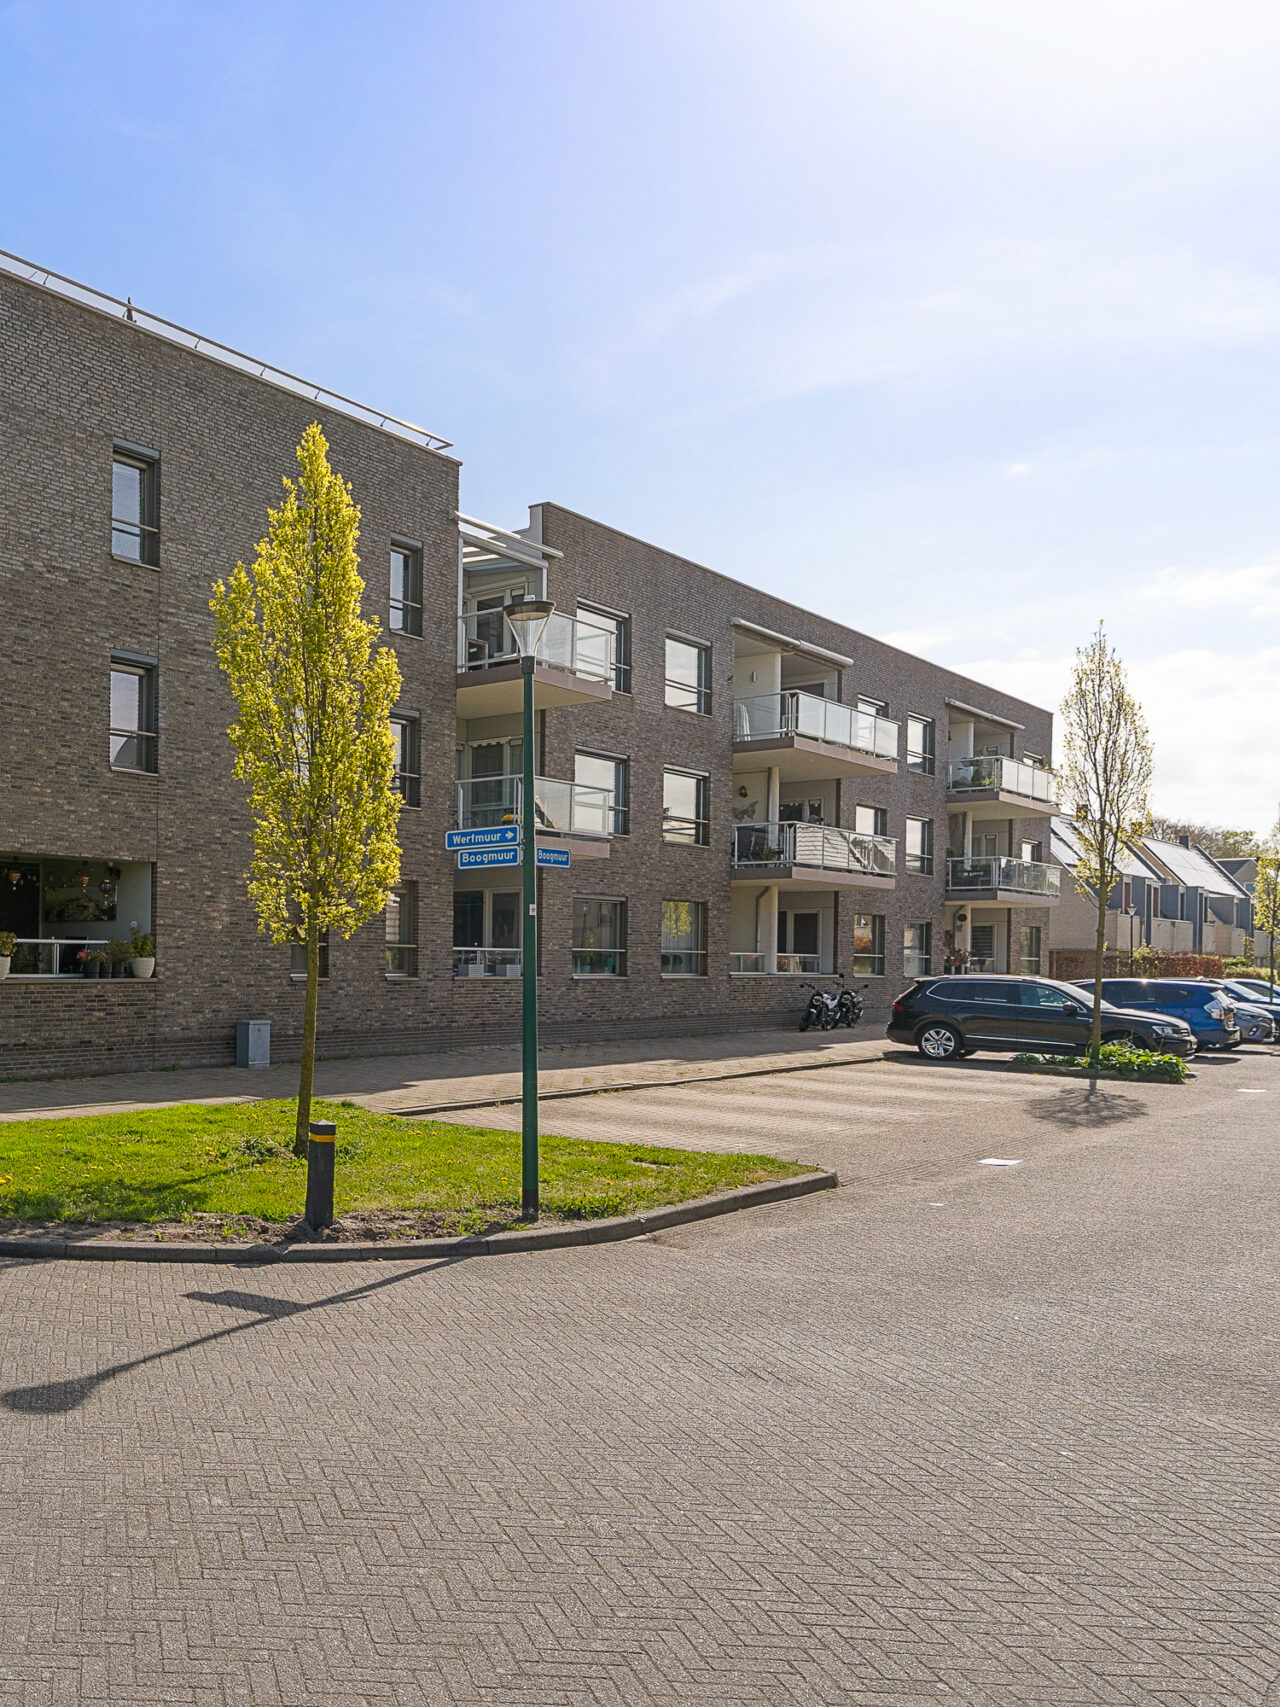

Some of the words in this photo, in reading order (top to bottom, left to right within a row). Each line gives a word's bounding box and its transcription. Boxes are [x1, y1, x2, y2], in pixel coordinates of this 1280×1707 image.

[452, 833, 502, 845] Werfmuur
[462, 851, 515, 864] Boogmuur
[538, 849, 568, 863] Boogmuur
